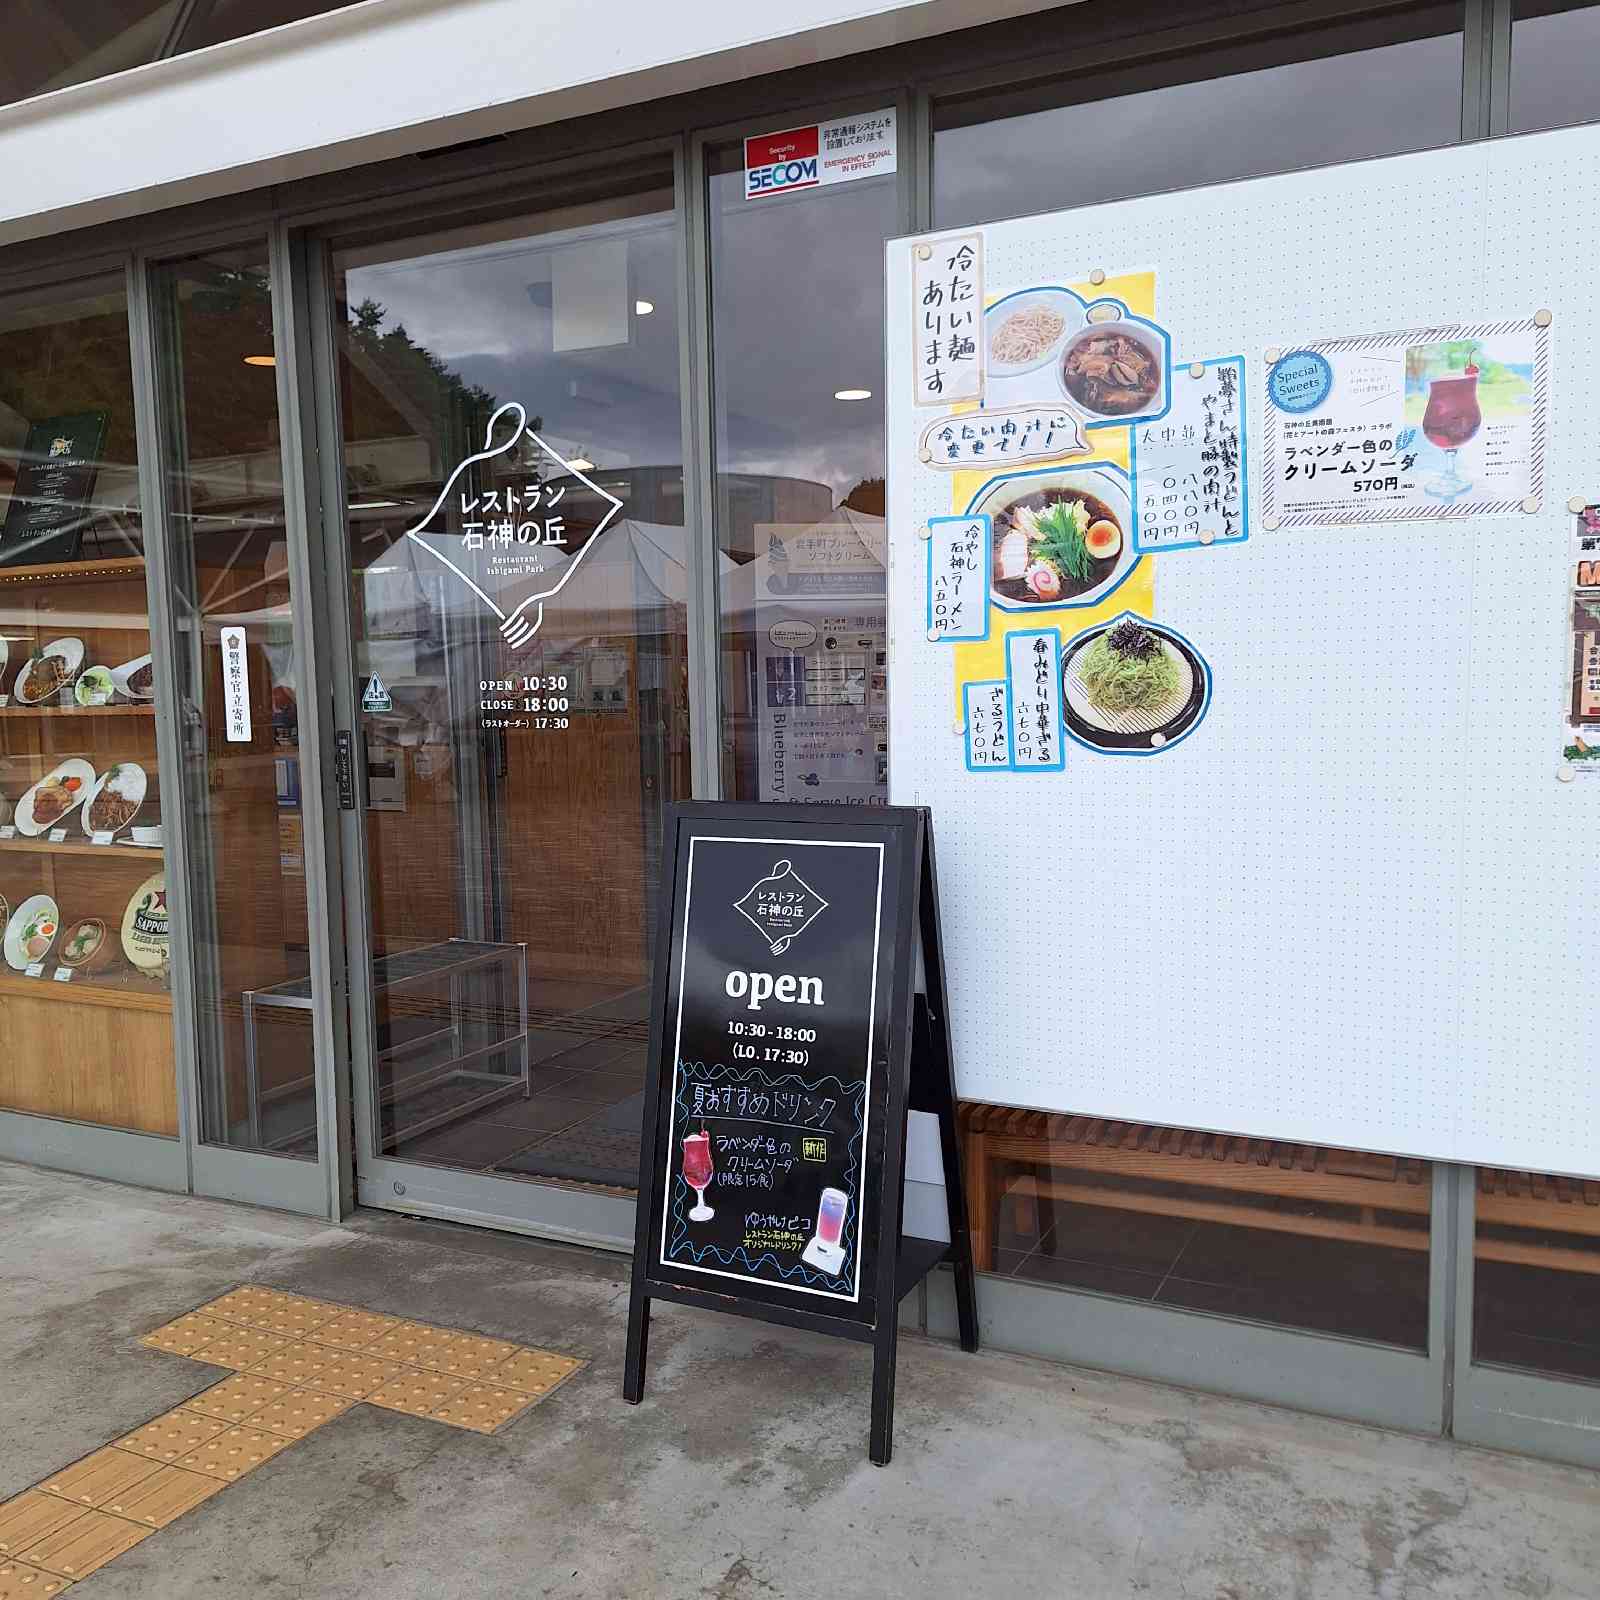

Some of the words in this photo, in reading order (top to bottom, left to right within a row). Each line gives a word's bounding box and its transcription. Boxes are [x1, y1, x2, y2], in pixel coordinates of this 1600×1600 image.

[824, 154, 866, 169] EMERGENCY
[867, 149, 893, 160] SIGNAL
[842, 164, 850, 173] IN
[851, 160, 876, 172] EFFECT
[749, 158, 817, 191] SECOM
[946, 244, 976, 362] 冷たい麺
[921, 279, 945, 394] あります
[1277, 363, 1319, 383] Special
[1279, 379, 1320, 396] Sweets
[937, 416, 1067, 441] 冷たい肉汁に
[1201, 393, 1221, 514] やまと豚の肉汁
[1284, 439, 1393, 460] ラベンダー色の
[1284, 452, 1419, 481] クリームソーダ
[1353, 476, 1399, 492] 570円
[460, 485, 566, 515] レストラン
[460, 515, 569, 552] 石神の丘
[963, 524, 981, 570] 冷やし
[491, 553, 539, 565] Restaurant
[486, 565, 524, 577] Ishigami
[525, 563, 545, 575] Park
[949, 541, 963, 630] 石神ラーメン
[228, 650, 245, 736] 警察官立寄所
[479, 680, 513, 692] OPEN
[521, 676, 568, 691] 10:30
[479, 699, 514, 711] CLOSE
[522, 697, 569, 712] 18:00
[534, 717, 569, 729] 17:30
[771, 713, 788, 794] Blueberry
[758, 891, 806, 903] レストラン
[756, 903, 805, 918] 石神の丘
[725, 970, 825, 1011] open
[690, 1082, 837, 1128] 夏おすすめドリンク
[715, 1135, 792, 1154] ラベンダー色の
[728, 1156, 799, 1174] クリームソーダ
